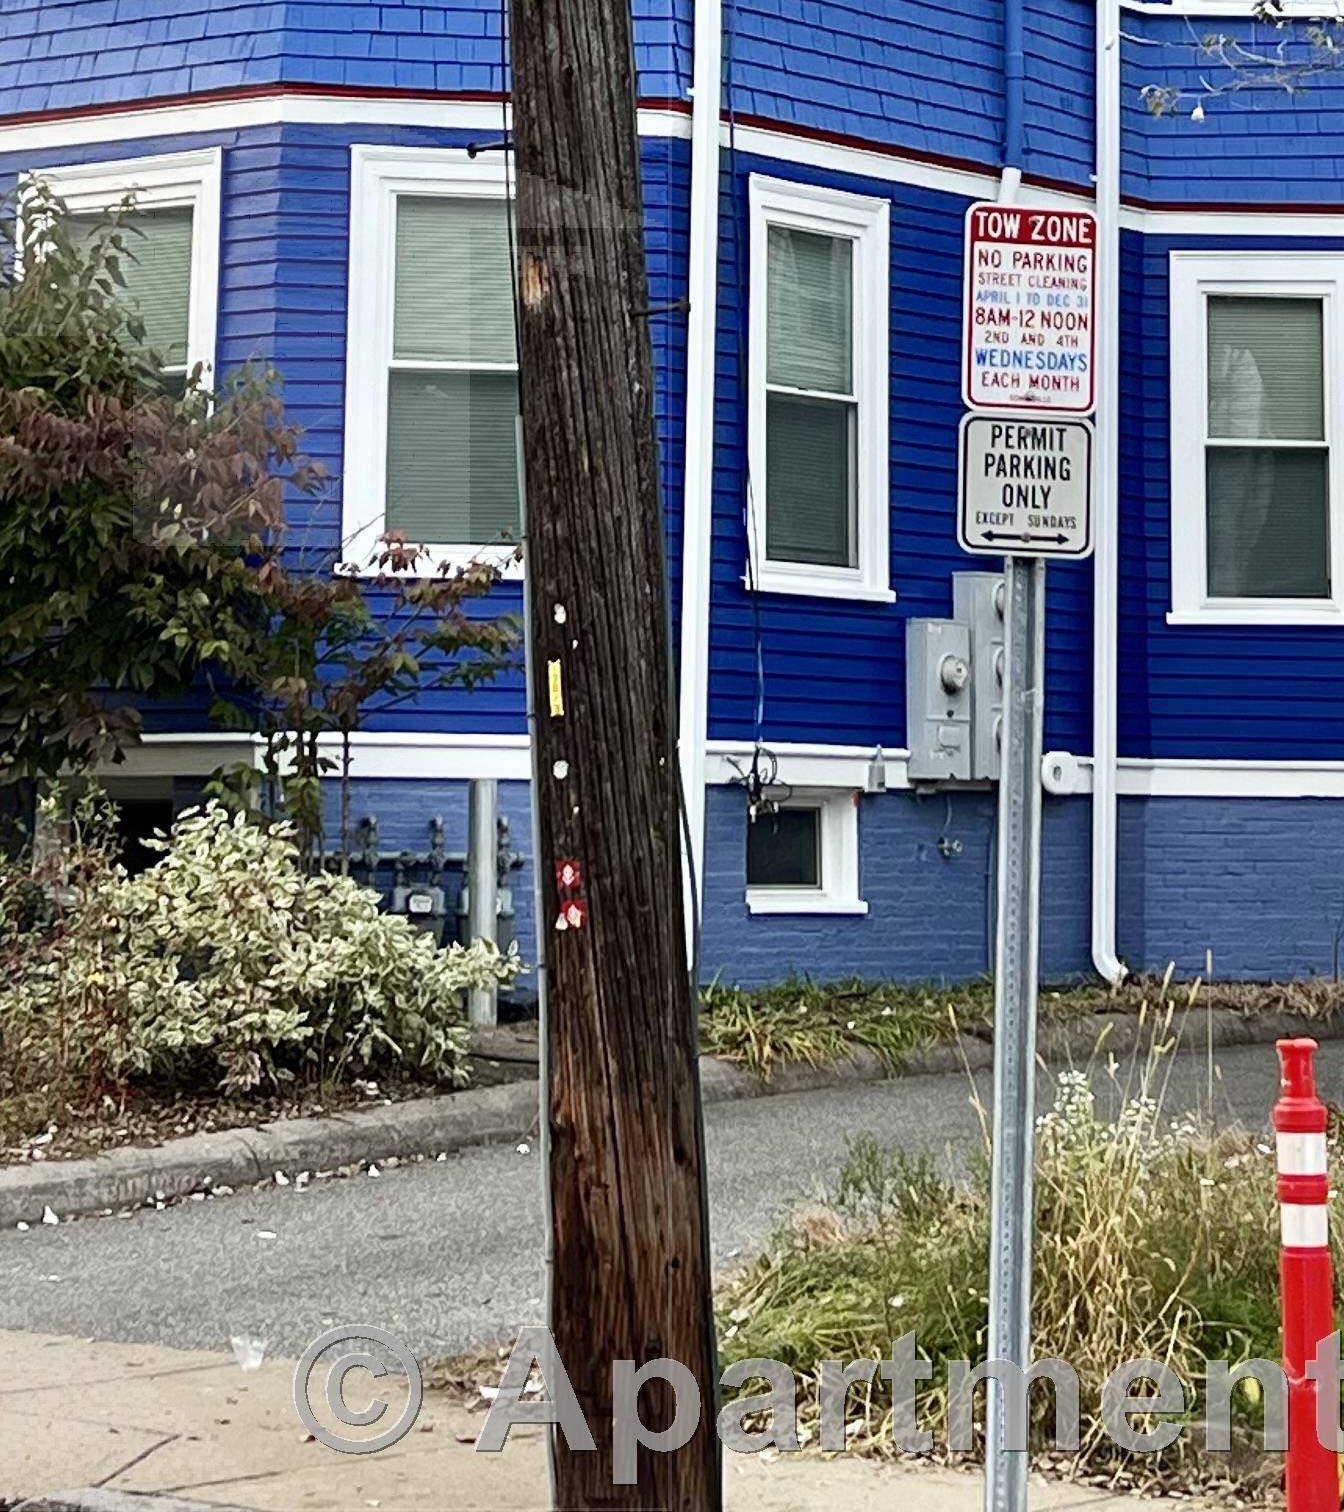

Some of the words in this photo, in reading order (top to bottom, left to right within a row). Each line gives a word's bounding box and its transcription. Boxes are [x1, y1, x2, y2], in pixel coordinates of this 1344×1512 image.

[975, 211, 1021, 239] TOW
[1028, 215, 1093, 244] ZONE
[978, 248, 1002, 268] NO
[1013, 251, 1088, 273] PARKING
[978, 272, 1022, 288] STREET
[1028, 275, 1088, 292] CLEANING
[975, 291, 1011, 304] APRIL
[1026, 292, 1040, 305] TO
[1047, 294, 1070, 307] DEC
[1076, 295, 1088, 308] 31
[975, 307, 1035, 329] 8AM-12
[1040, 311, 1088, 331] NOON
[984, 330, 1009, 344] 2ND
[1021, 332, 1045, 346] AND
[1056, 335, 1079, 347] 4TH
[975, 348, 1088, 372] WEDNESDAYS
[981, 371, 1020, 389] EACH
[1028, 374, 1080, 392] MONTH
[991, 423, 1067, 452] PERMIT
[984, 452, 1071, 481] PARKING
[1001, 483, 1052, 509] ONLY
[975, 511, 1014, 526] EXCEPT
[1027, 514, 1077, 530] SUNDAYS
